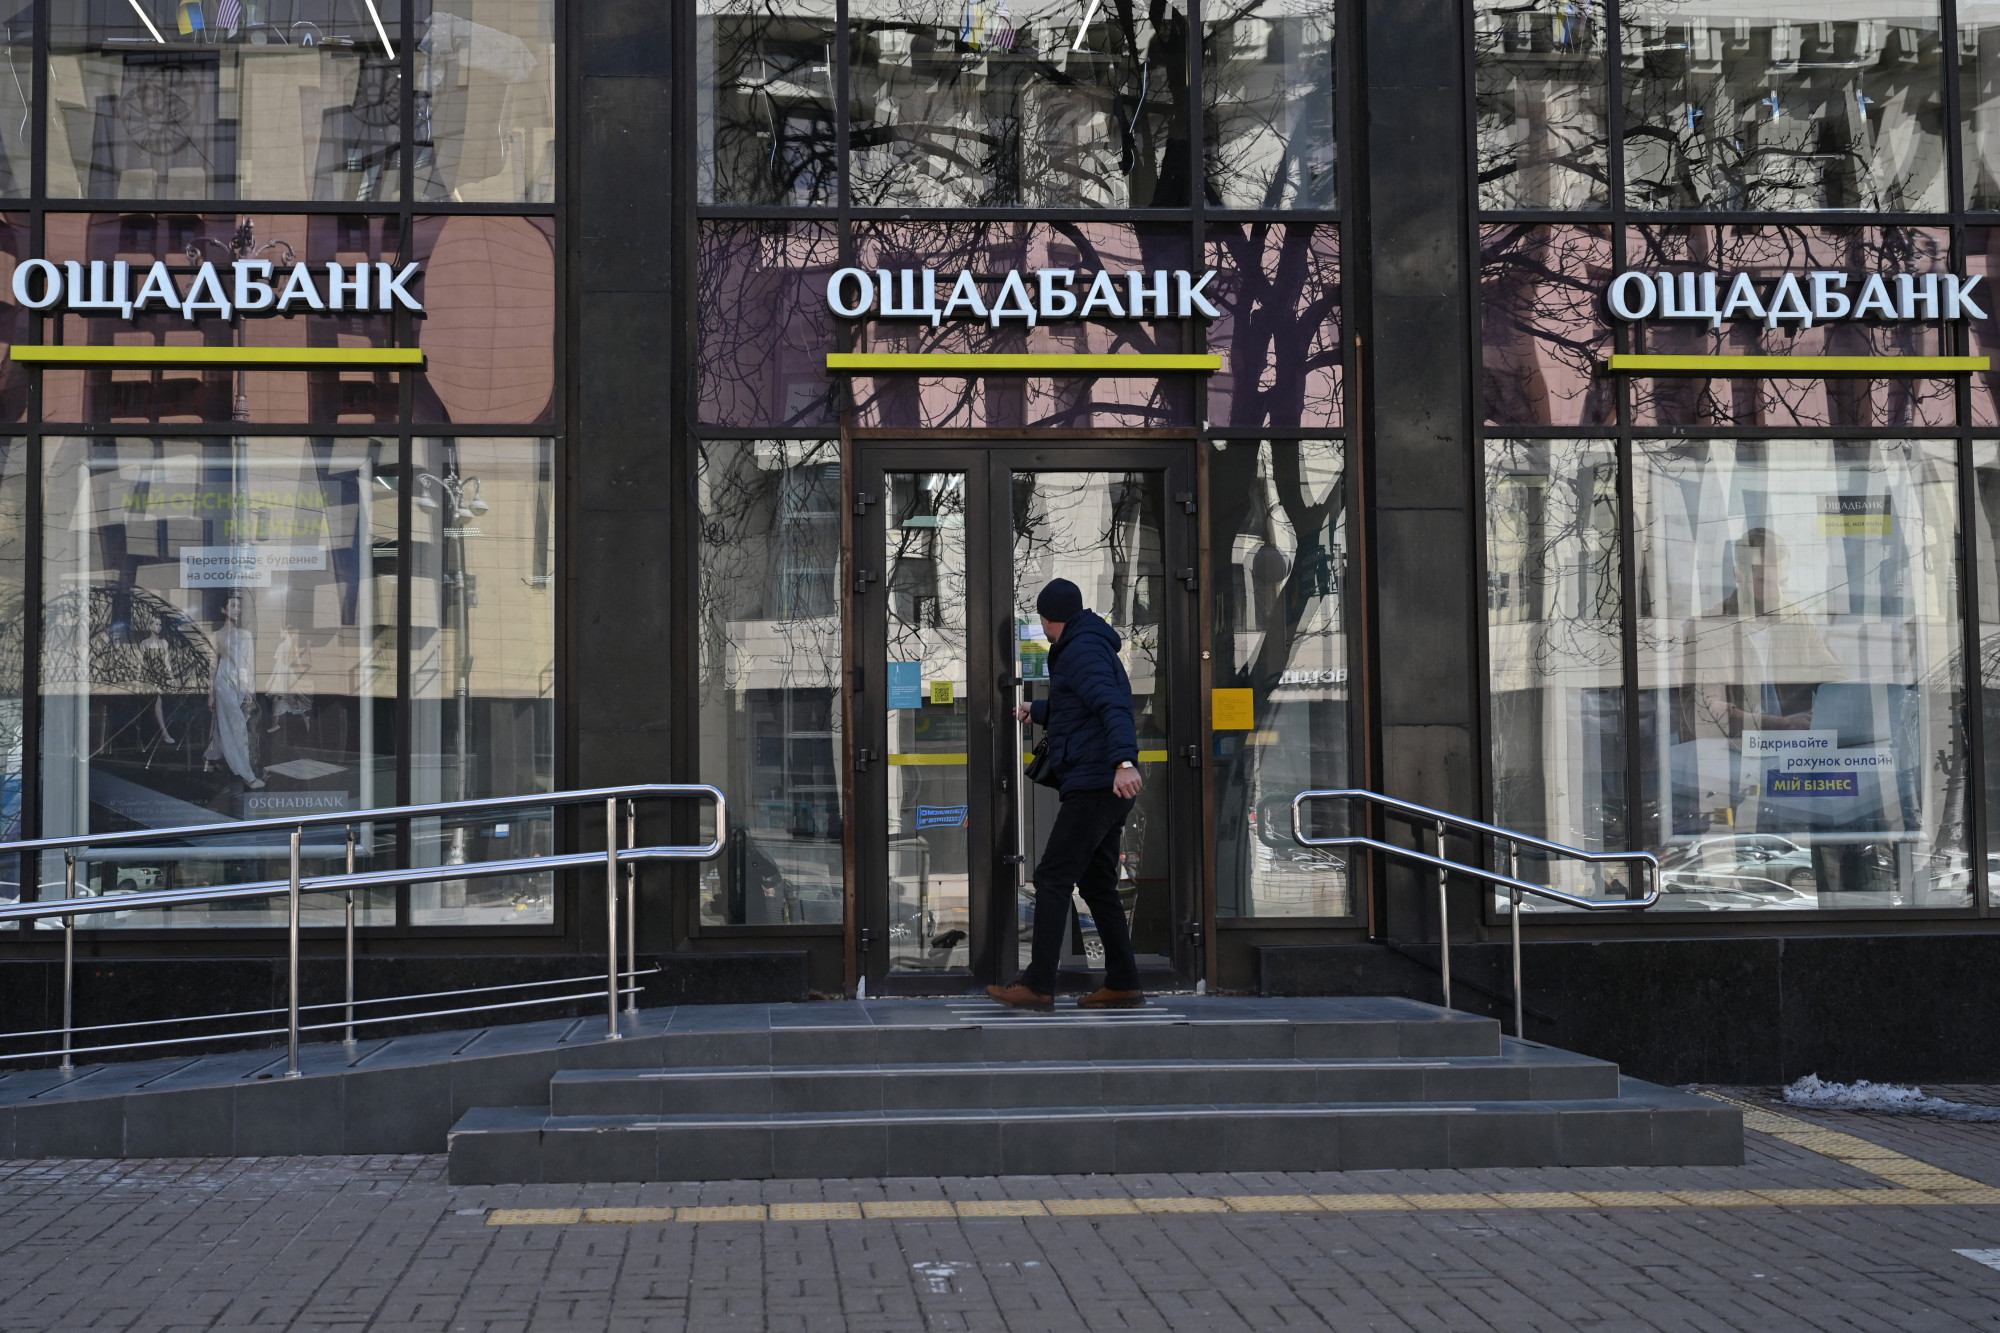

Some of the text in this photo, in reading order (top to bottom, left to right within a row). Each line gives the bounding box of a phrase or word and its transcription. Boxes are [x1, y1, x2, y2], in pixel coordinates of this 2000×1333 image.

[12, 258, 425, 321] ОЩАДБАНК
[826, 267, 1221, 329] ОЩАДБАНК
[1607, 271, 1989, 330] ОЩАДБАНК
[170, 492, 329, 510] OSCHADBANK
[1824, 501, 1884, 511] ОЩАДБАНК
[224, 519, 329, 537] PREMIUM
[187, 554, 318, 567] Перетворює буденне
[187, 570, 262, 580] на особливе
[1749, 737, 1828, 751] Відкривайте
[1787, 754, 1893, 770] рахунок онлайн
[1774, 777, 1852, 791] МІЙ БІЗНЕС
[249, 797, 344, 809] OSCHADBANK
